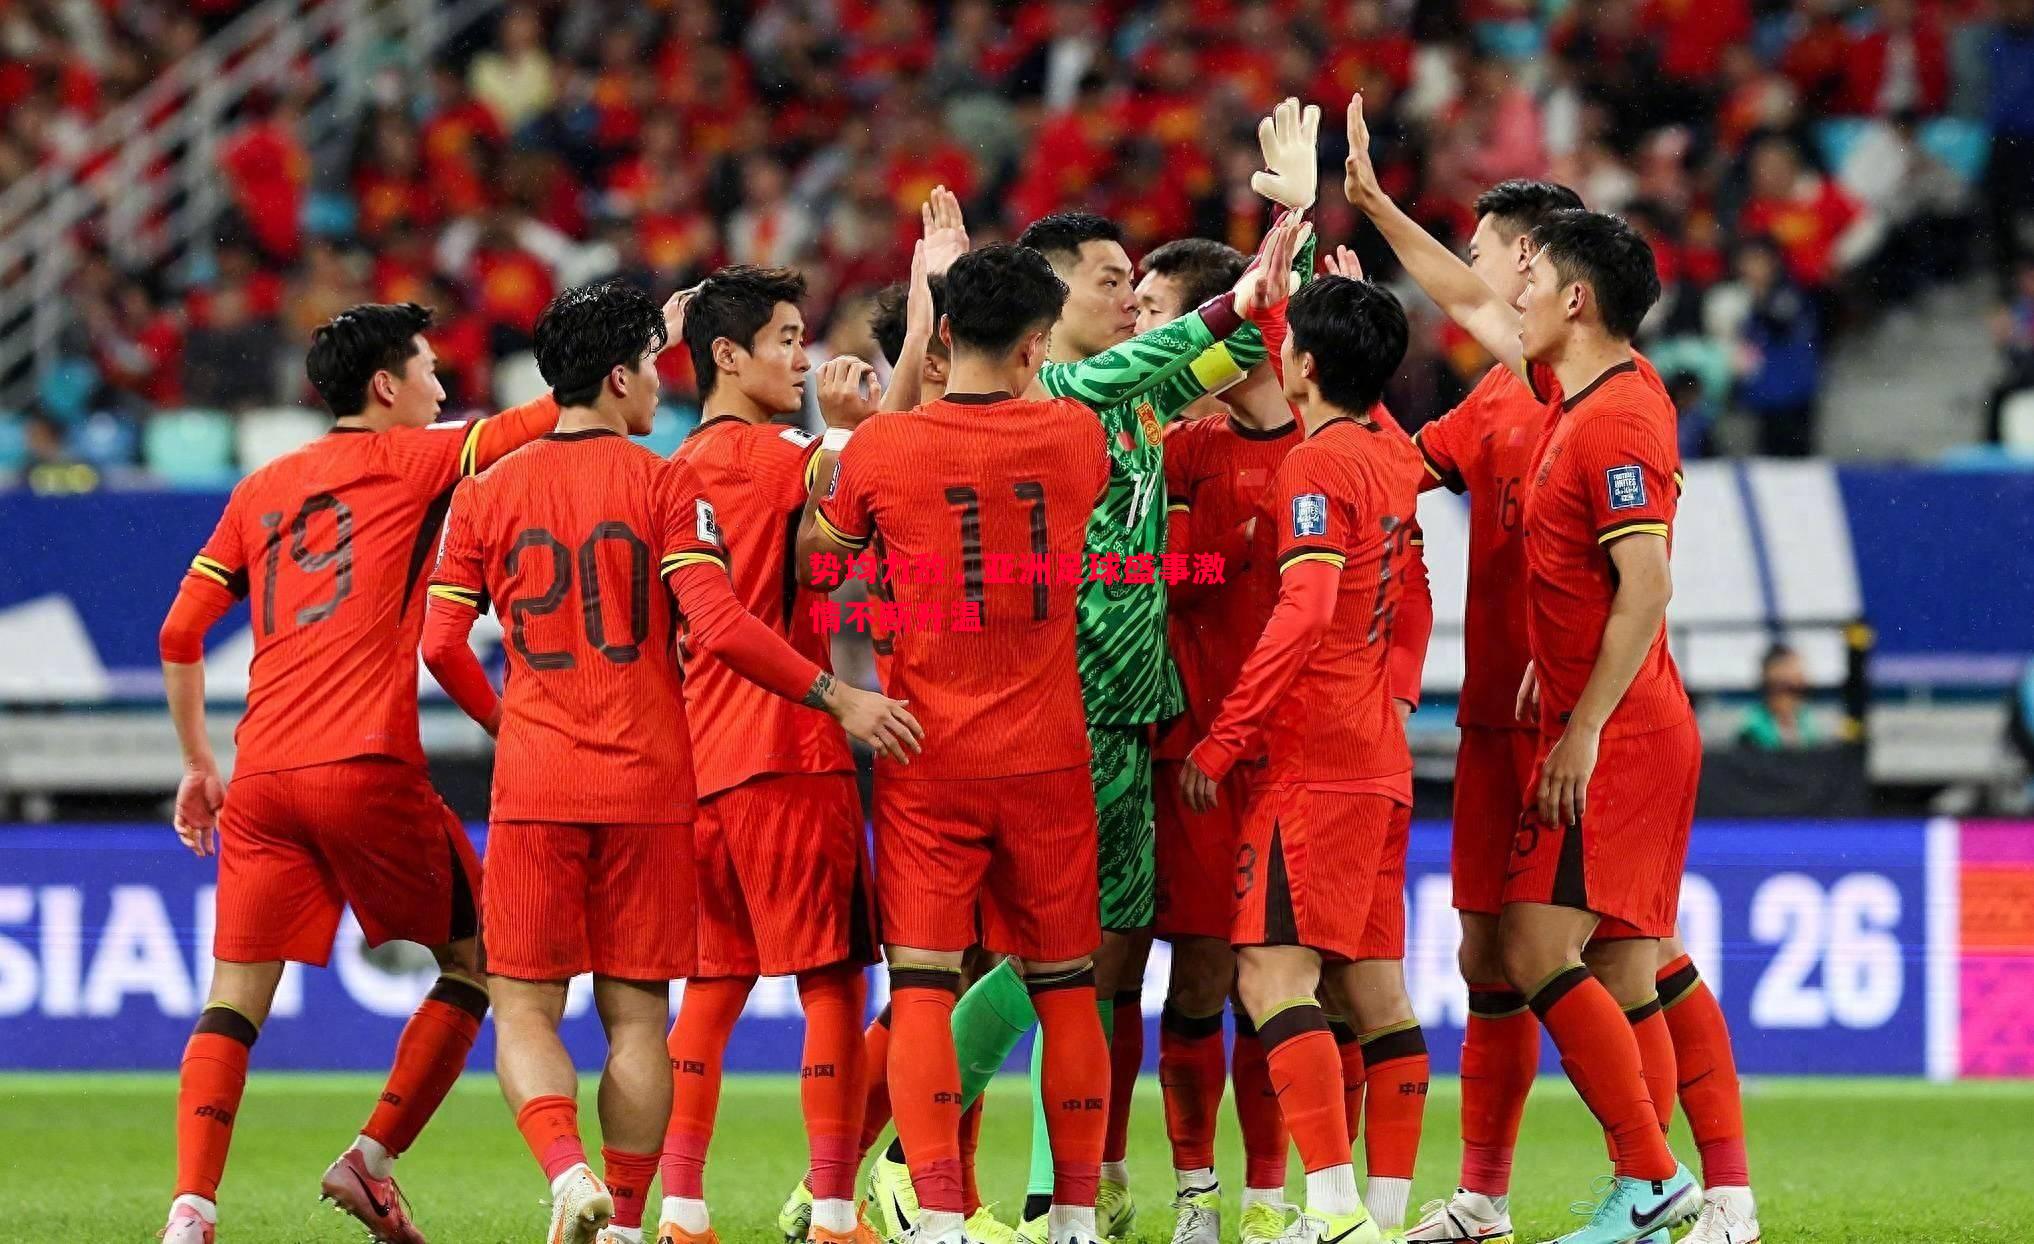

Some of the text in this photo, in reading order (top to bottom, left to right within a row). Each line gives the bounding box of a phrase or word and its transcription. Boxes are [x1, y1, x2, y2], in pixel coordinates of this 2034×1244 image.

[261, 494, 352, 636] 19
[504, 521, 649, 670] 20
[944, 481, 1048, 624] 11
[0, 884, 304, 1018] IA
[1750, 871, 1904, 1030] 26
[1062, 1098, 1104, 1111] 中国
